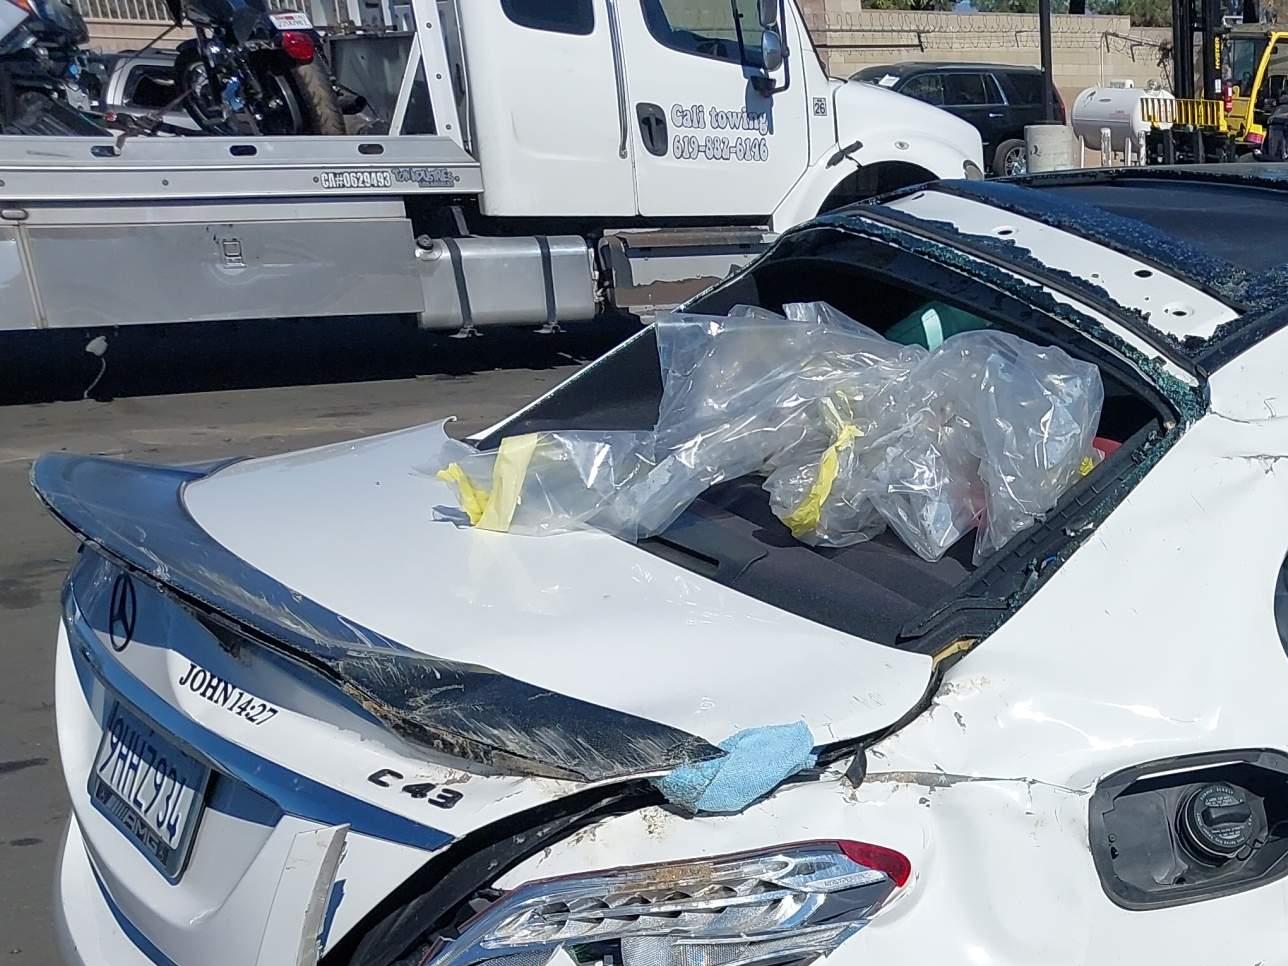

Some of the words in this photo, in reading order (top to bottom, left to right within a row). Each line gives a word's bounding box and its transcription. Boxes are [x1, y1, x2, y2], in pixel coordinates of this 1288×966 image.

[671, 104, 706, 129] Cali
[709, 106, 769, 136] towing
[814, 102, 826, 114] 26
[320, 170, 392, 189] CA#0629493
[179, 663, 236, 707] JOHN
[227, 692, 279, 725] 14:27
[99, 717, 181, 843] 9HHZ934
[368, 768, 404, 788] C
[402, 782, 464, 809] 43
